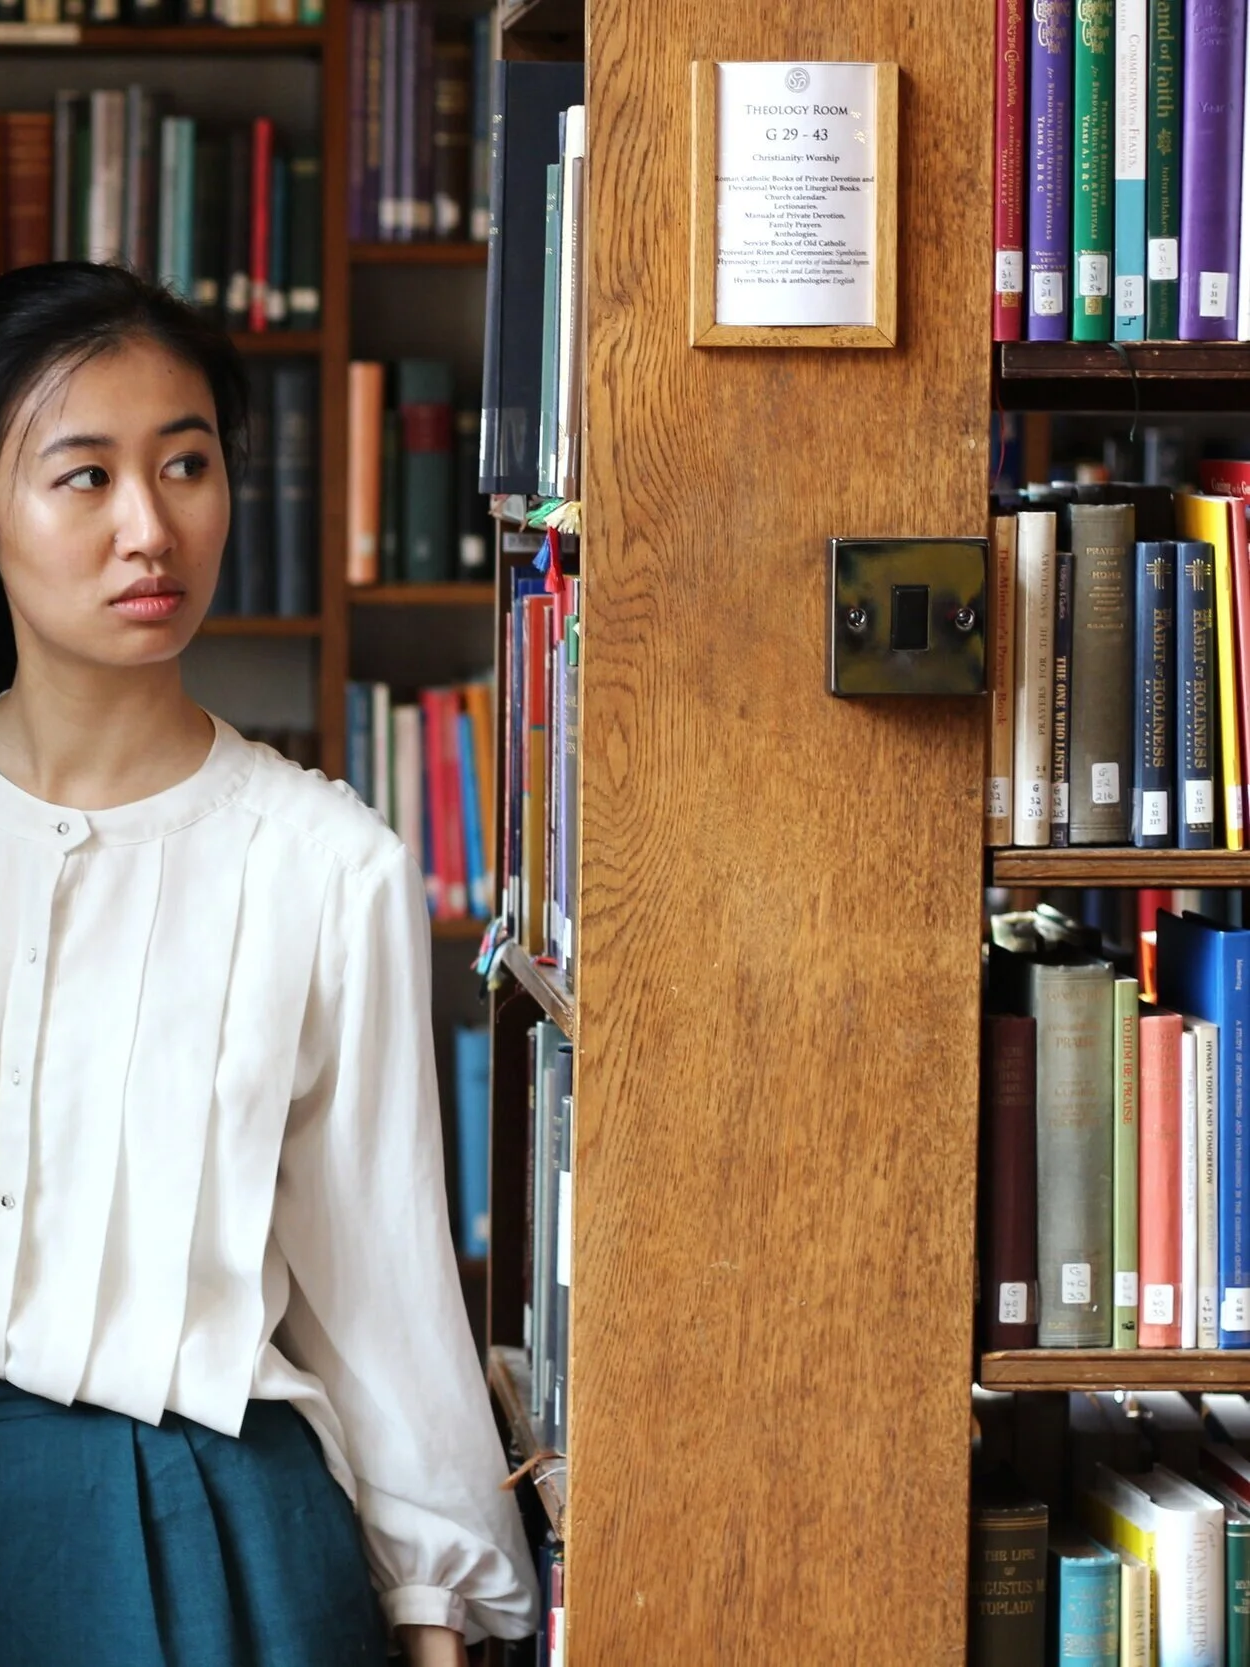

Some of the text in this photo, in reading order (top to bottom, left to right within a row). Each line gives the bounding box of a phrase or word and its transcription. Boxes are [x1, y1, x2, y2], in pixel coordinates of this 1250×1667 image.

[1157, 2, 1174, 118] and of Faith
[744, 104, 849, 116] THEOLOGY ROOM
[1128, 34, 1141, 168] COMMENTARY FEASTS,
[765, 128, 777, 141] G
[782, 128, 799, 141] 29
[812, 128, 829, 141] 43
[1037, 116, 1045, 145] YEARS
[1082, 114, 1090, 144] YEARS
[752, 153, 840, 164] Christianity: Worship
[769, 184, 792, 192] Works
[805, 184, 838, 192] Liturgical
[839, 184, 861, 192] Books.
[1082, 184, 1090, 192] C
[1046, 192, 1054, 240] FESTIVALS
[1091, 192, 1099, 240] FESTIVALS
[833, 277, 856, 285] English
[998, 548, 1008, 570] The
[1092, 572, 1121, 580] HOME
[1038, 552, 1050, 736] PRAYERS FOR THE SANCTUARY
[1056, 656, 1066, 682] THE
[1056, 684, 1066, 708] ONE
[1152, 608, 1166, 768] HABIT OF HOLINESS
[1193, 608, 1207, 769] HABIT OF HOLINESS
[997, 693, 1006, 727] Book
[1055, 712, 1066, 740] WHO
[1122, 1015, 1134, 1125] TO HIM BE PRAISE
[1206, 1076, 1214, 1106] TODAY
[1206, 1111, 1214, 1127] AND
[1206, 1130, 1214, 1185] TOMORROW
[985, 1549, 1036, 1562] THE LIFE
[980, 1600, 1035, 1616] TOPLADY
[1193, 1532, 1208, 1658] HYMN WRITERS
